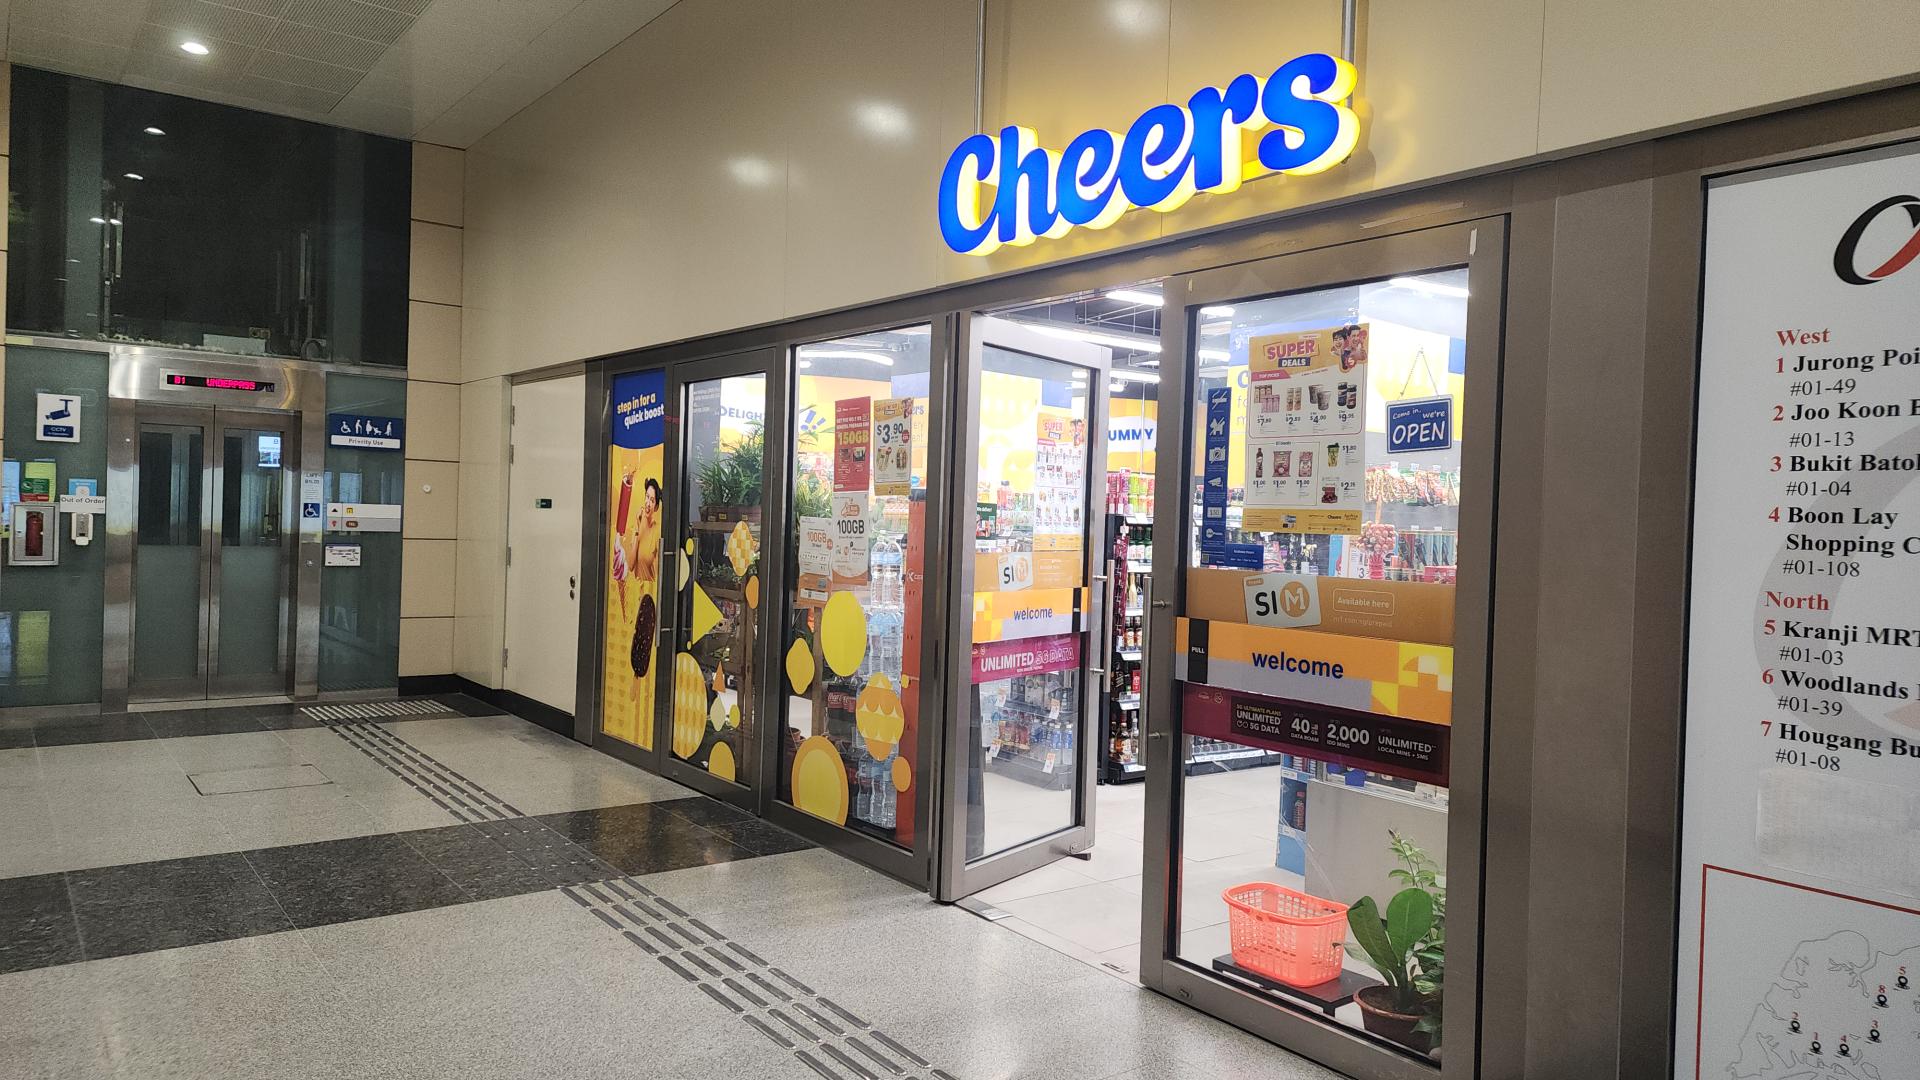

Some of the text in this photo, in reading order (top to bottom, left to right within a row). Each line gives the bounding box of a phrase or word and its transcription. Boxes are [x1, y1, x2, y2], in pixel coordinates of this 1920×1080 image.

[938, 53, 1354, 254] Cheers
[1776, 328, 1831, 346] West
[1267, 339, 1315, 361] SUPER
[1281, 358, 1306, 367] DEALS
[1776, 357, 1784, 373] 1
[1793, 355, 1875, 373] Jurong
[174, 375, 256, 390] B1 UNDERPASS
[1790, 378, 1856, 396] #01-49
[617, 393, 656, 415] step in for a
[1772, 405, 1784, 421] 2
[1791, 404, 1830, 421] Joo
[1838, 401, 1900, 419] Koon
[624, 404, 665, 430] quick boost
[720, 405, 763, 420] DELIGH
[1310, 415, 1326, 423] $4.00
[1392, 410, 1410, 420] Come
[1422, 409, 1445, 418] we're
[838, 431, 869, 446] 150GB
[877, 422, 904, 444] $3.90
[1108, 428, 1154, 441] UMMY
[1392, 420, 1446, 445] OPEN
[1789, 431, 1855, 448] #01-13
[348, 438, 372, 447] Priority
[1770, 453, 1920, 472] 3 Bukit Bato
[1253, 480, 1266, 488] $1.00
[1273, 480, 1286, 488] $1.00
[1296, 479, 1310, 488] $1.00
[1786, 481, 1852, 496] #01-04
[1768, 506, 1898, 530] 4 Boon Lay
[837, 519, 865, 534] 100GB
[807, 531, 827, 543] 100GB
[1786, 533, 1895, 558] Shopping
[1782, 560, 1860, 577] #01-108
[1255, 588, 1306, 617] SIM
[1337, 597, 1390, 609] Available here
[1764, 591, 1830, 611] North
[1013, 607, 1053, 621] welcome
[1764, 619, 1775, 635] 5
[1783, 620, 1858, 646] Kranji
[1191, 646, 1205, 654] PULL
[1779, 645, 1844, 666] #01-03
[980, 652, 1034, 672] UNLIMITED
[1049, 647, 1074, 663] DATA
[1252, 651, 1344, 679] welcome
[1762, 668, 1774, 684] 6
[1781, 669, 1909, 700] Woodlands
[1243, 705, 1265, 714] ULTIMATE
[1265, 709, 1282, 717] PLANS
[1777, 695, 1843, 716] #01-39
[1236, 710, 1281, 726] UNLIMITED
[1291, 717, 1310, 733] 40
[1249, 723, 1280, 735] 5G DATA
[1290, 732, 1303, 740] DATA
[1327, 723, 1370, 745] 2,000
[1337, 741, 1350, 749] MINS
[1760, 720, 1772, 737] 7
[1779, 722, 1882, 758] Hougang
[1377, 745, 1395, 755] LOCAL
[1396, 749, 1411, 757] MINS
[1416, 752, 1429, 761] SMS
[1775, 748, 1841, 772] #01-08
[1899, 966, 1906, 975] 5
[1872, 1020, 1879, 1028] 3
